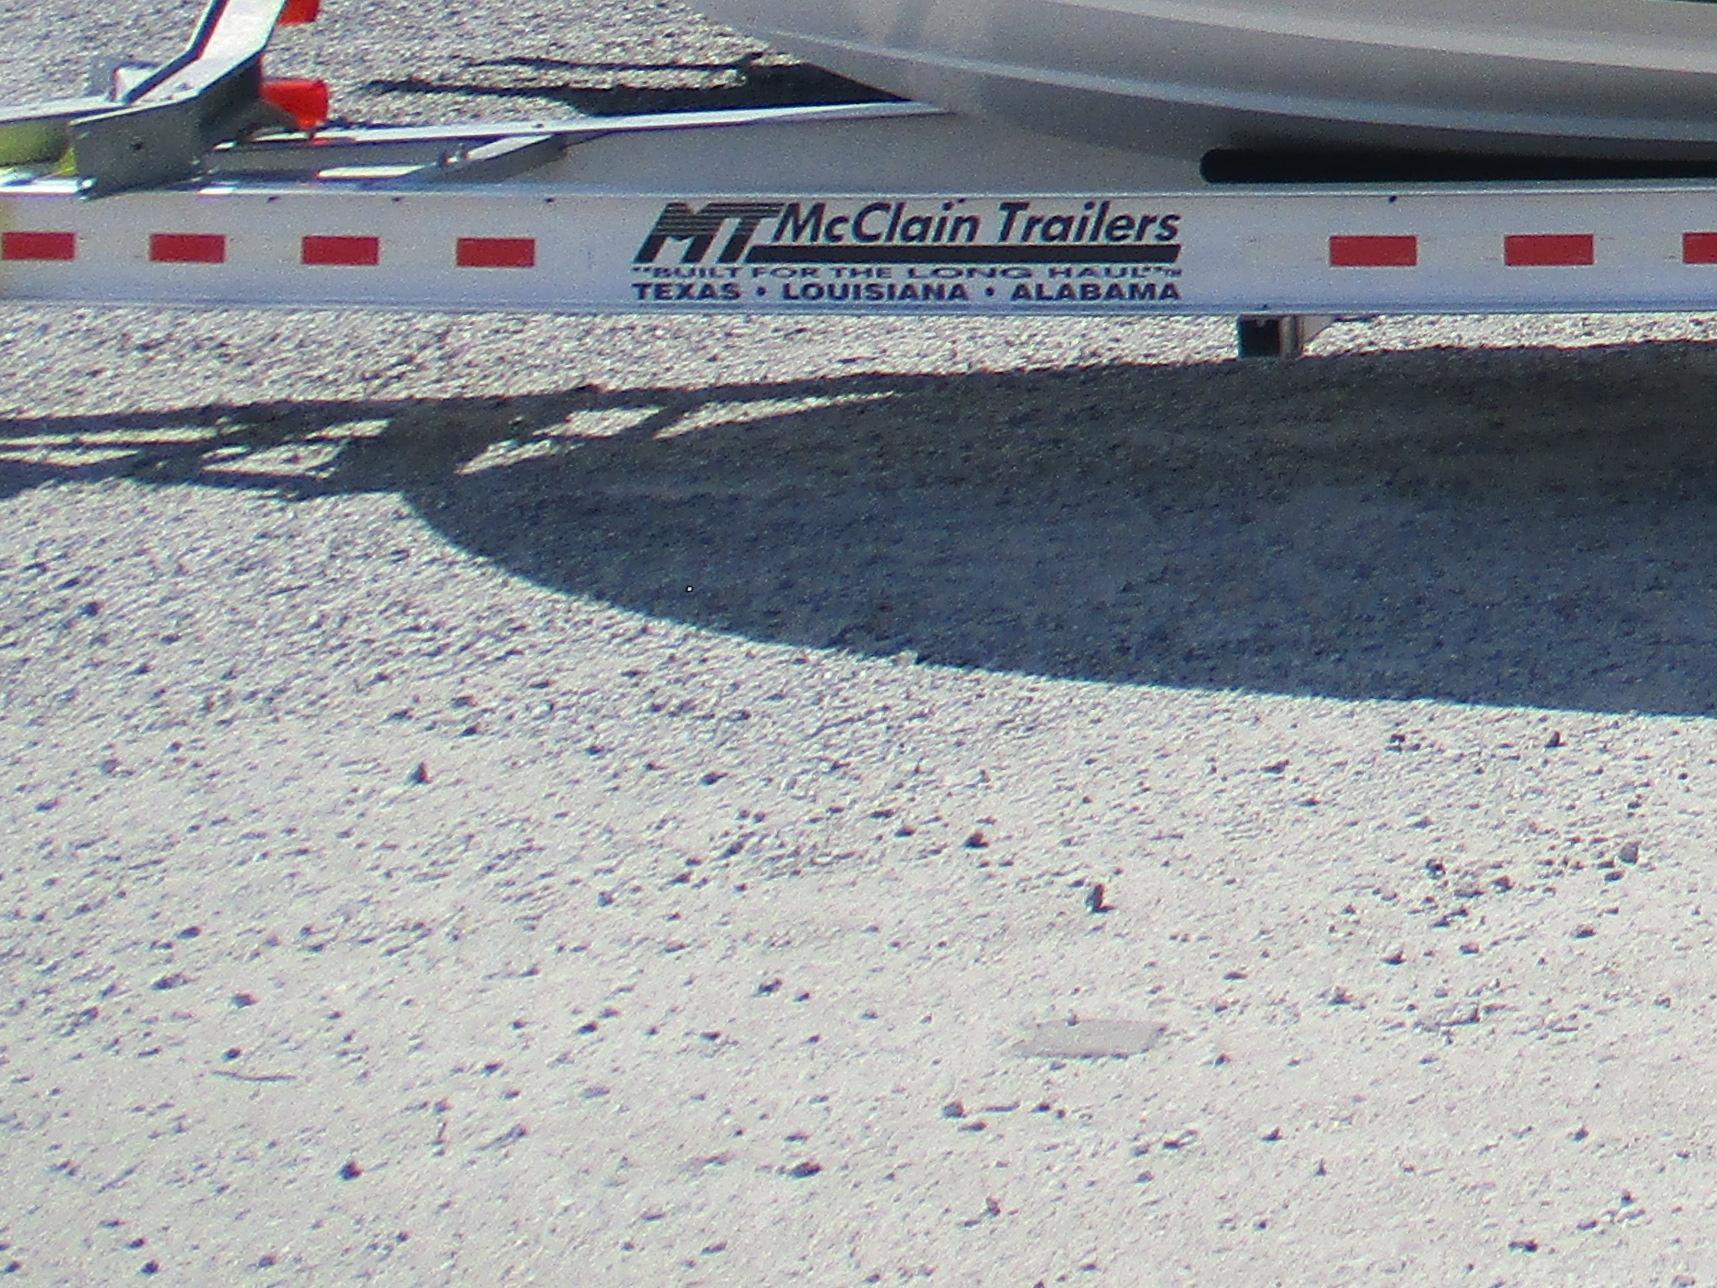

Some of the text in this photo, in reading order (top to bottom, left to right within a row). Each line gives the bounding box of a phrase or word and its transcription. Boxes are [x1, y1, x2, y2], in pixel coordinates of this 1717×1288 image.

[772, 200, 1182, 243] McClain Trailers
[752, 266, 821, 279] FOR
[829, 266, 893, 279] THE
[908, 266, 1033, 280] LONG
[631, 281, 1182, 301] TEXAS LOUISIANA ALABAMA
